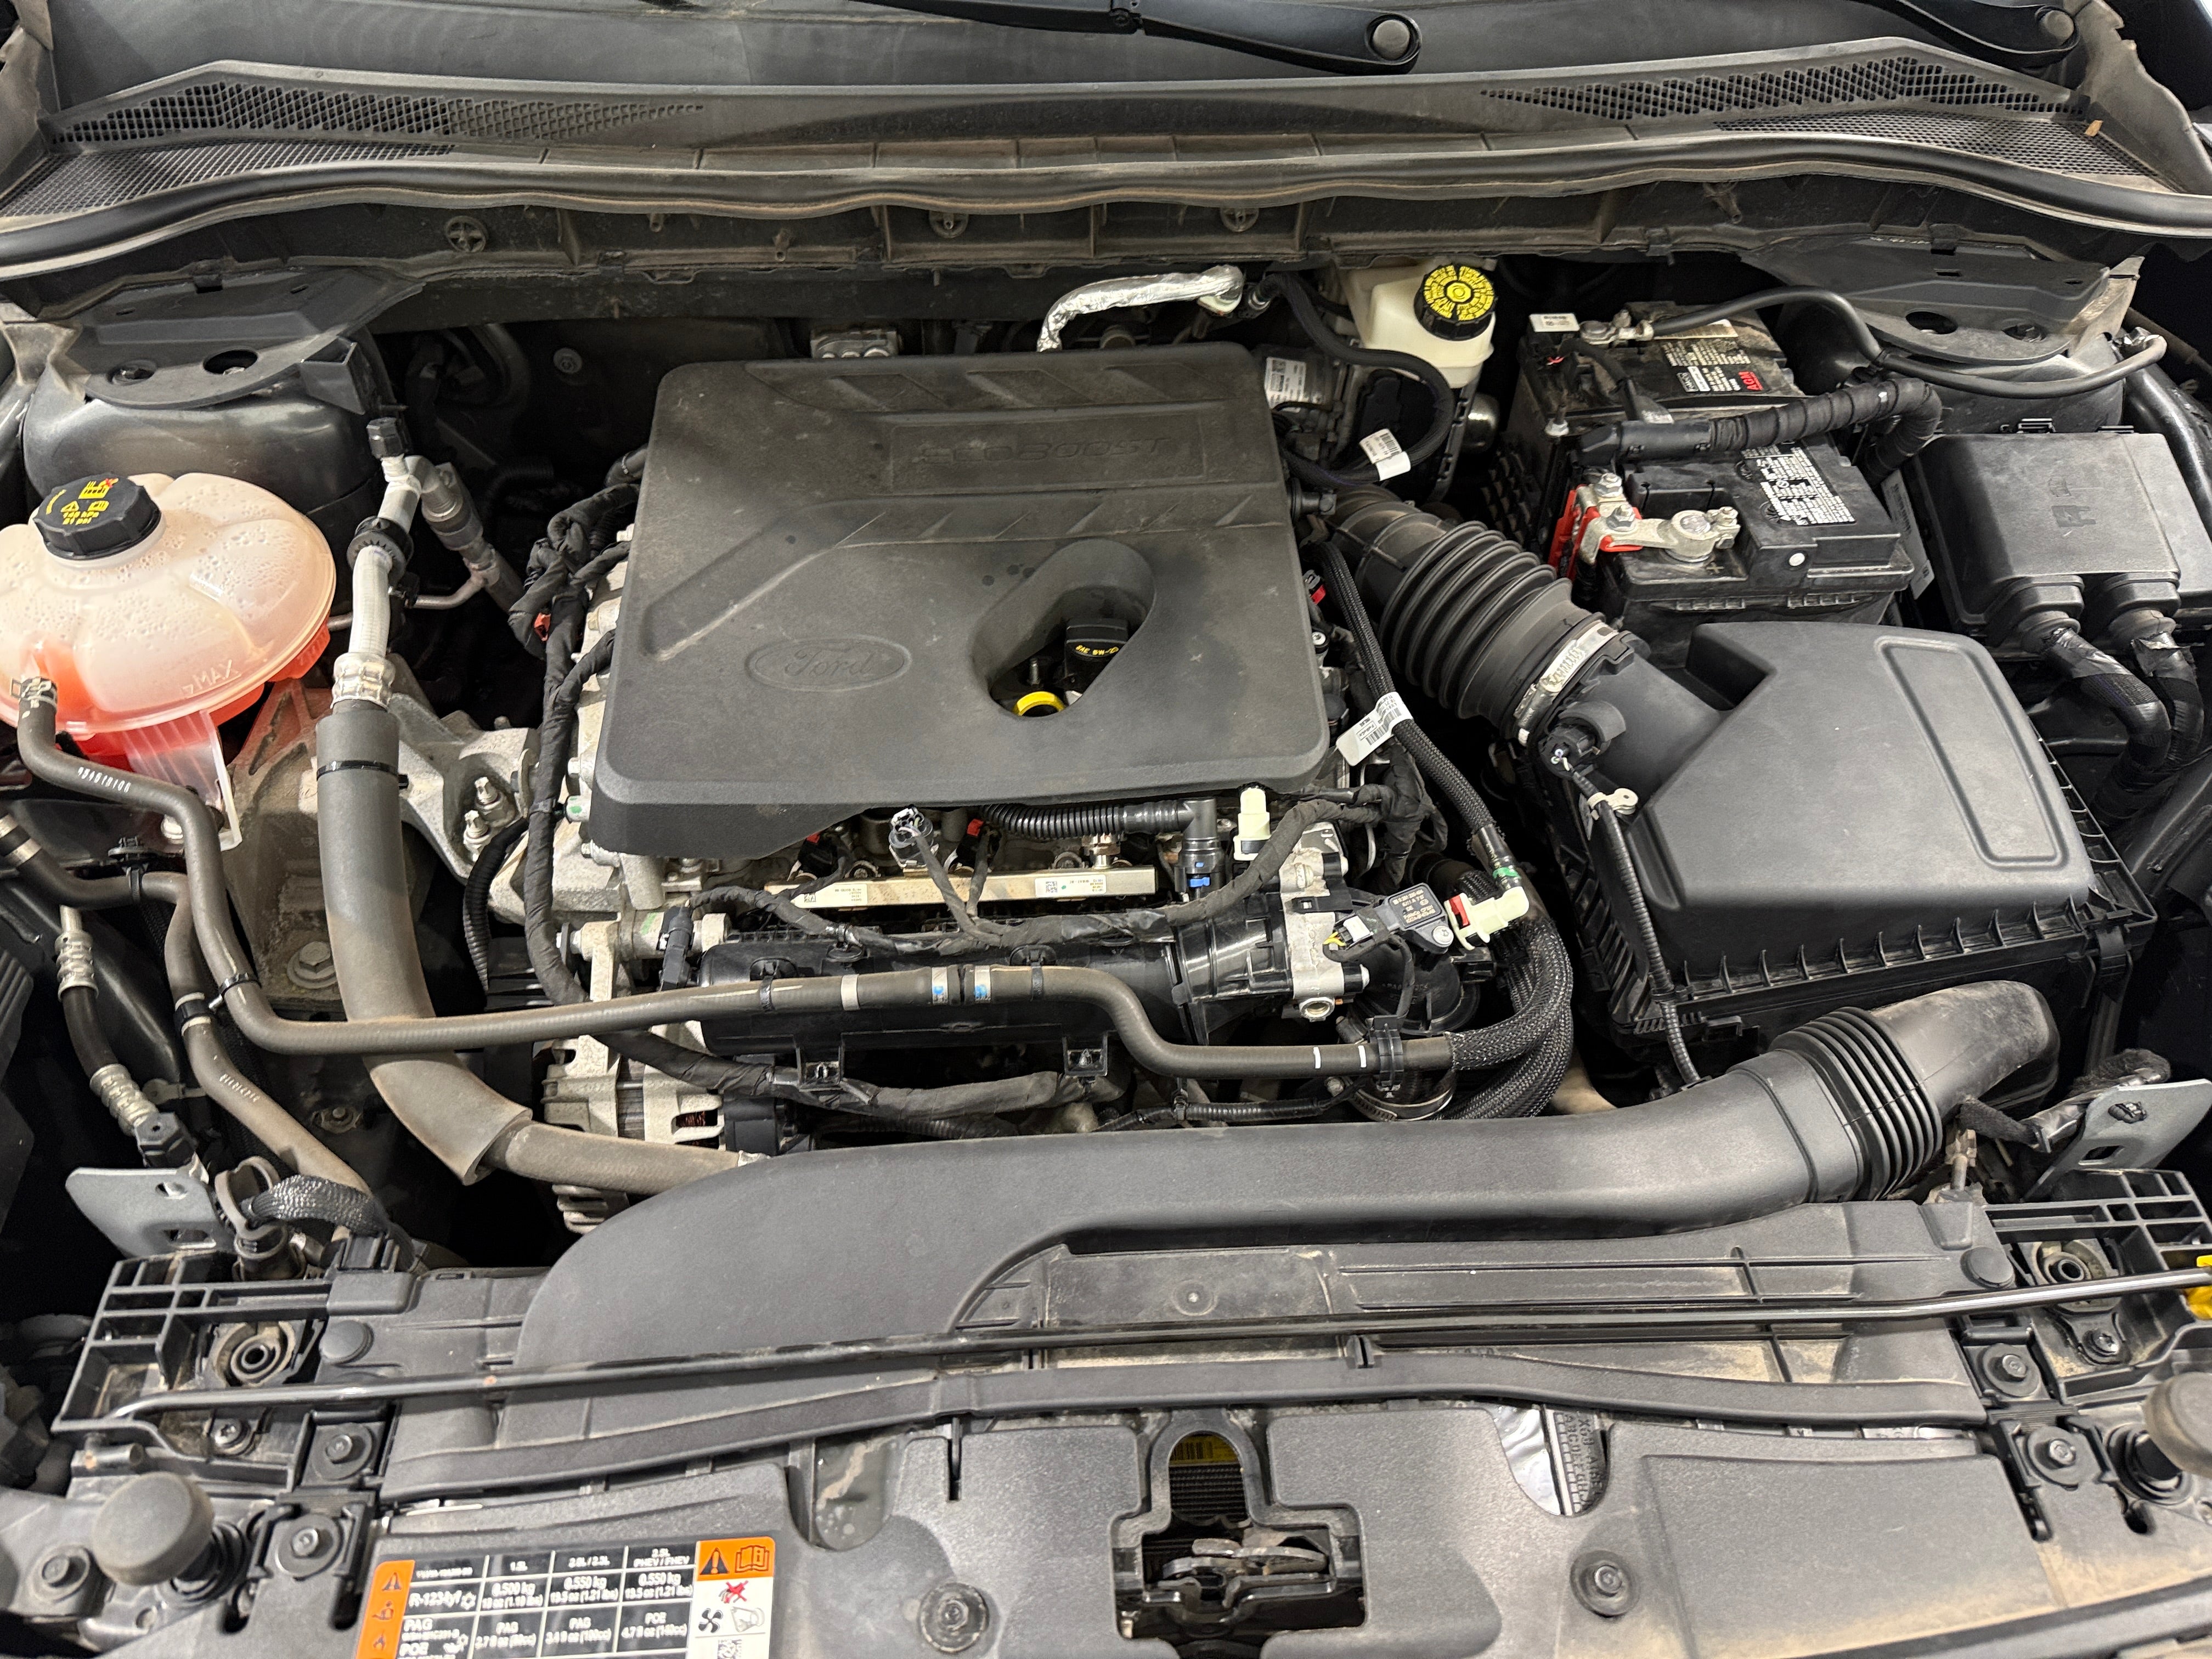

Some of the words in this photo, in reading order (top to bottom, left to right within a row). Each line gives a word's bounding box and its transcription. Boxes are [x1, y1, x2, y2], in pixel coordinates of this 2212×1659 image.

[1738, 371, 1759, 390] AGM
[1075, 645, 1091, 654] SAE
[784, 647, 881, 678] Ford
[192, 659, 239, 690] MAX
[634, 1558, 659, 1567] PHEV
[564, 1576, 592, 1590] 0.550
[592, 1576, 607, 1589] kg
[639, 1572, 667, 1587] 0.550
[667, 1572, 681, 1587] kg
[492, 1582, 521, 1596] 0.500
[521, 1582, 535, 1596] kg
[568, 1592, 579, 1602] oz
[601, 1588, 618, 1600] lbs)
[643, 1588, 654, 1598] oz
[675, 1584, 693, 1596] lbs)
[403, 1618, 433, 1632] PAG
[569, 1617, 591, 1630] PAG
[645, 1612, 667, 1624] POE
[495, 1621, 519, 1634] PAG
[399, 1641, 430, 1657] POE
